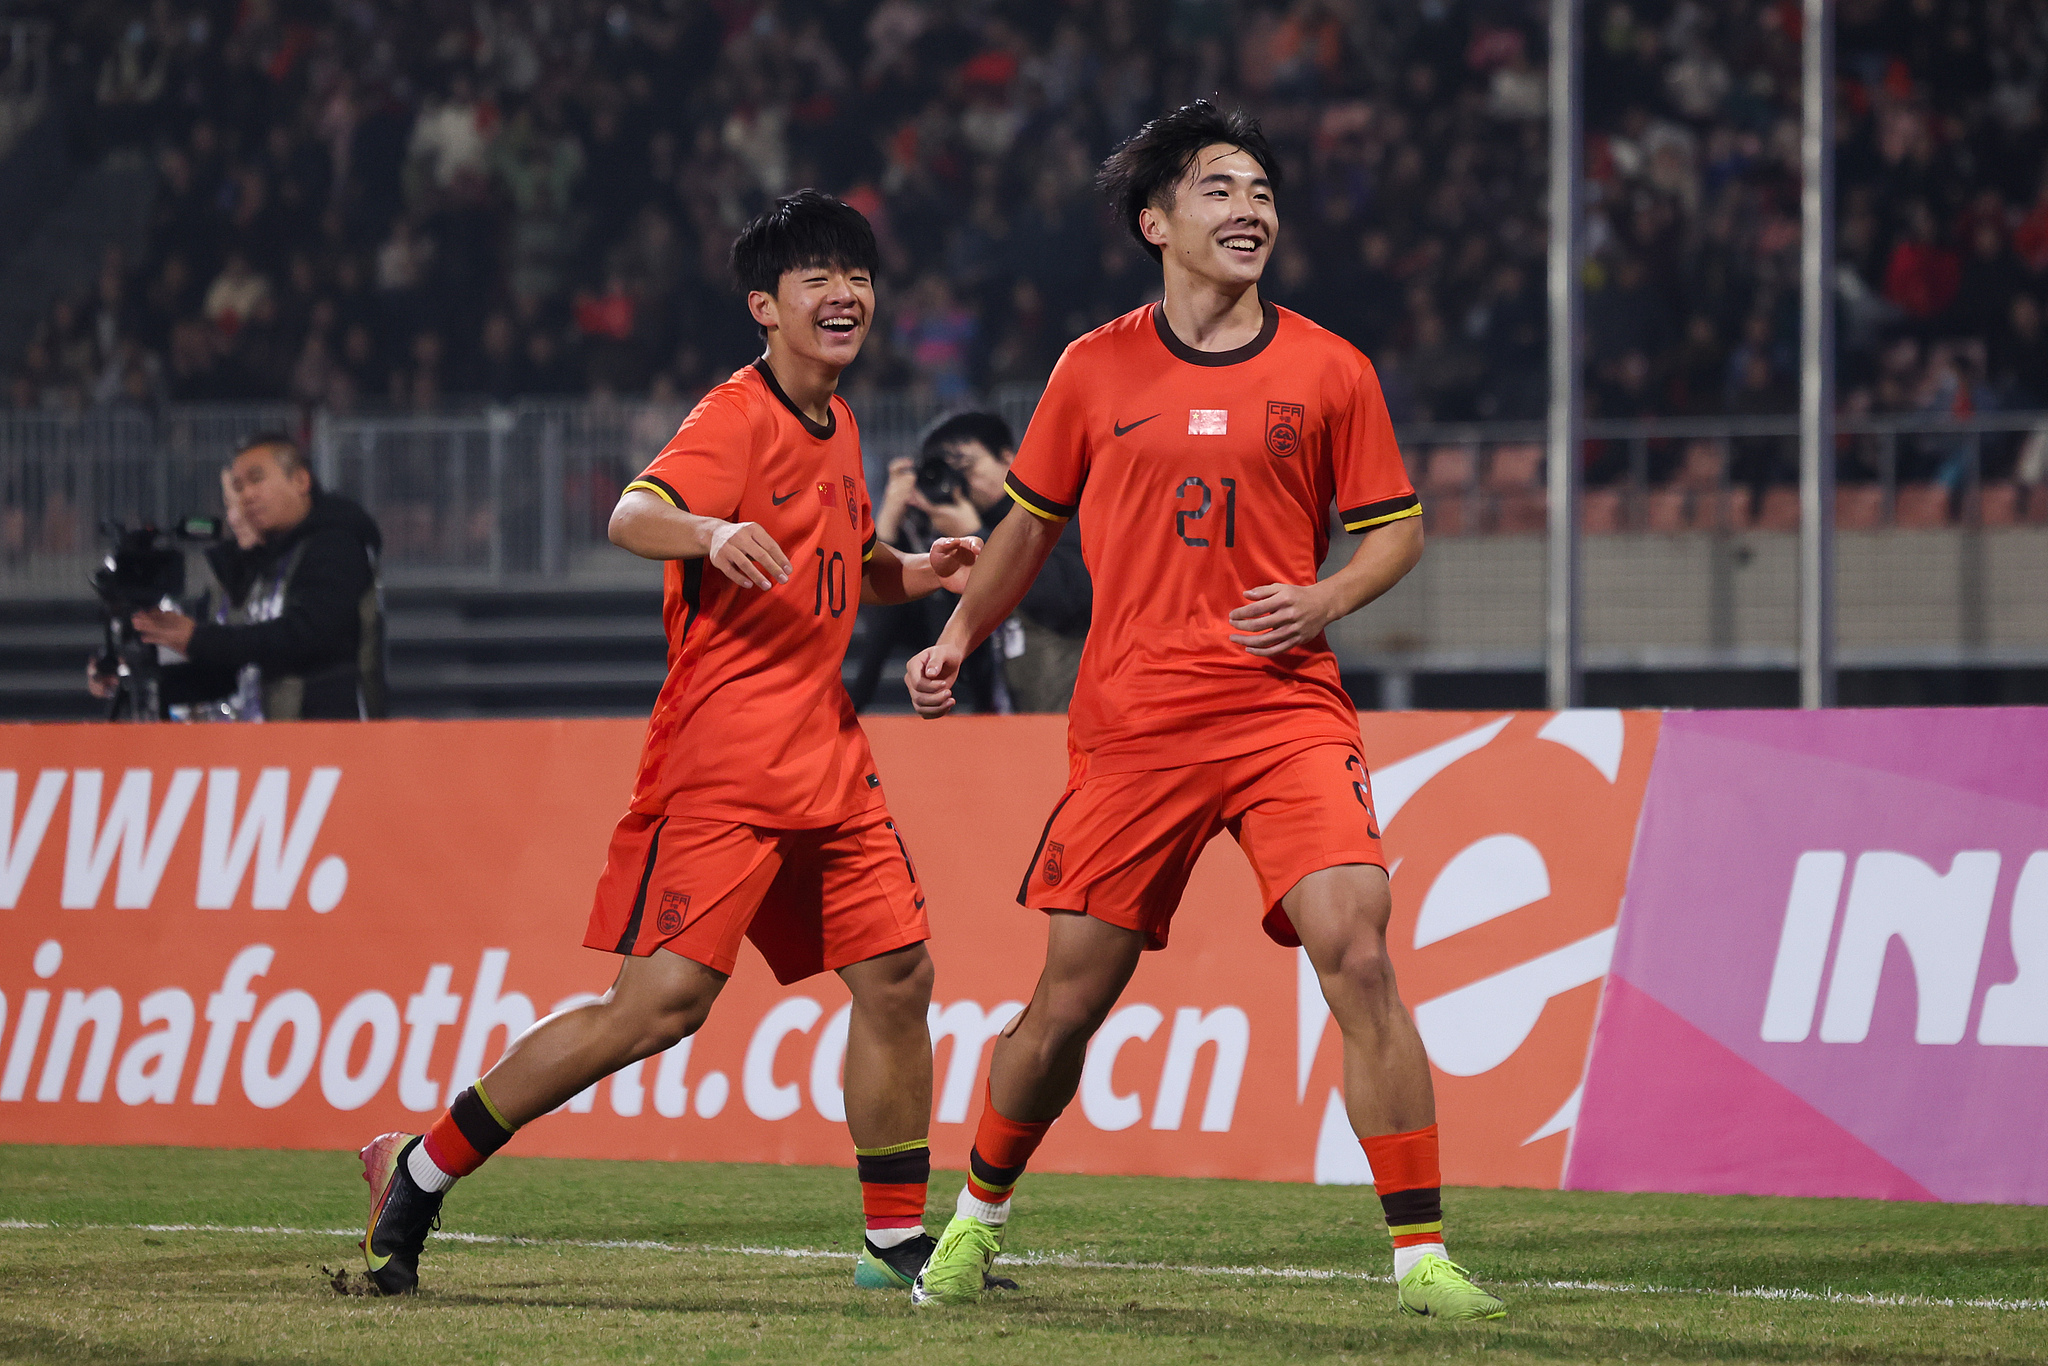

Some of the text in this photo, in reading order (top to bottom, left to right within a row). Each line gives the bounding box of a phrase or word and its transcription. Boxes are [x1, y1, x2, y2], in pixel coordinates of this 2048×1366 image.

[1270, 405, 1301, 417] CFA
[1176, 476, 1236, 548] 21
[814, 547, 847, 618] 10
[664, 894, 687, 905] CFA
